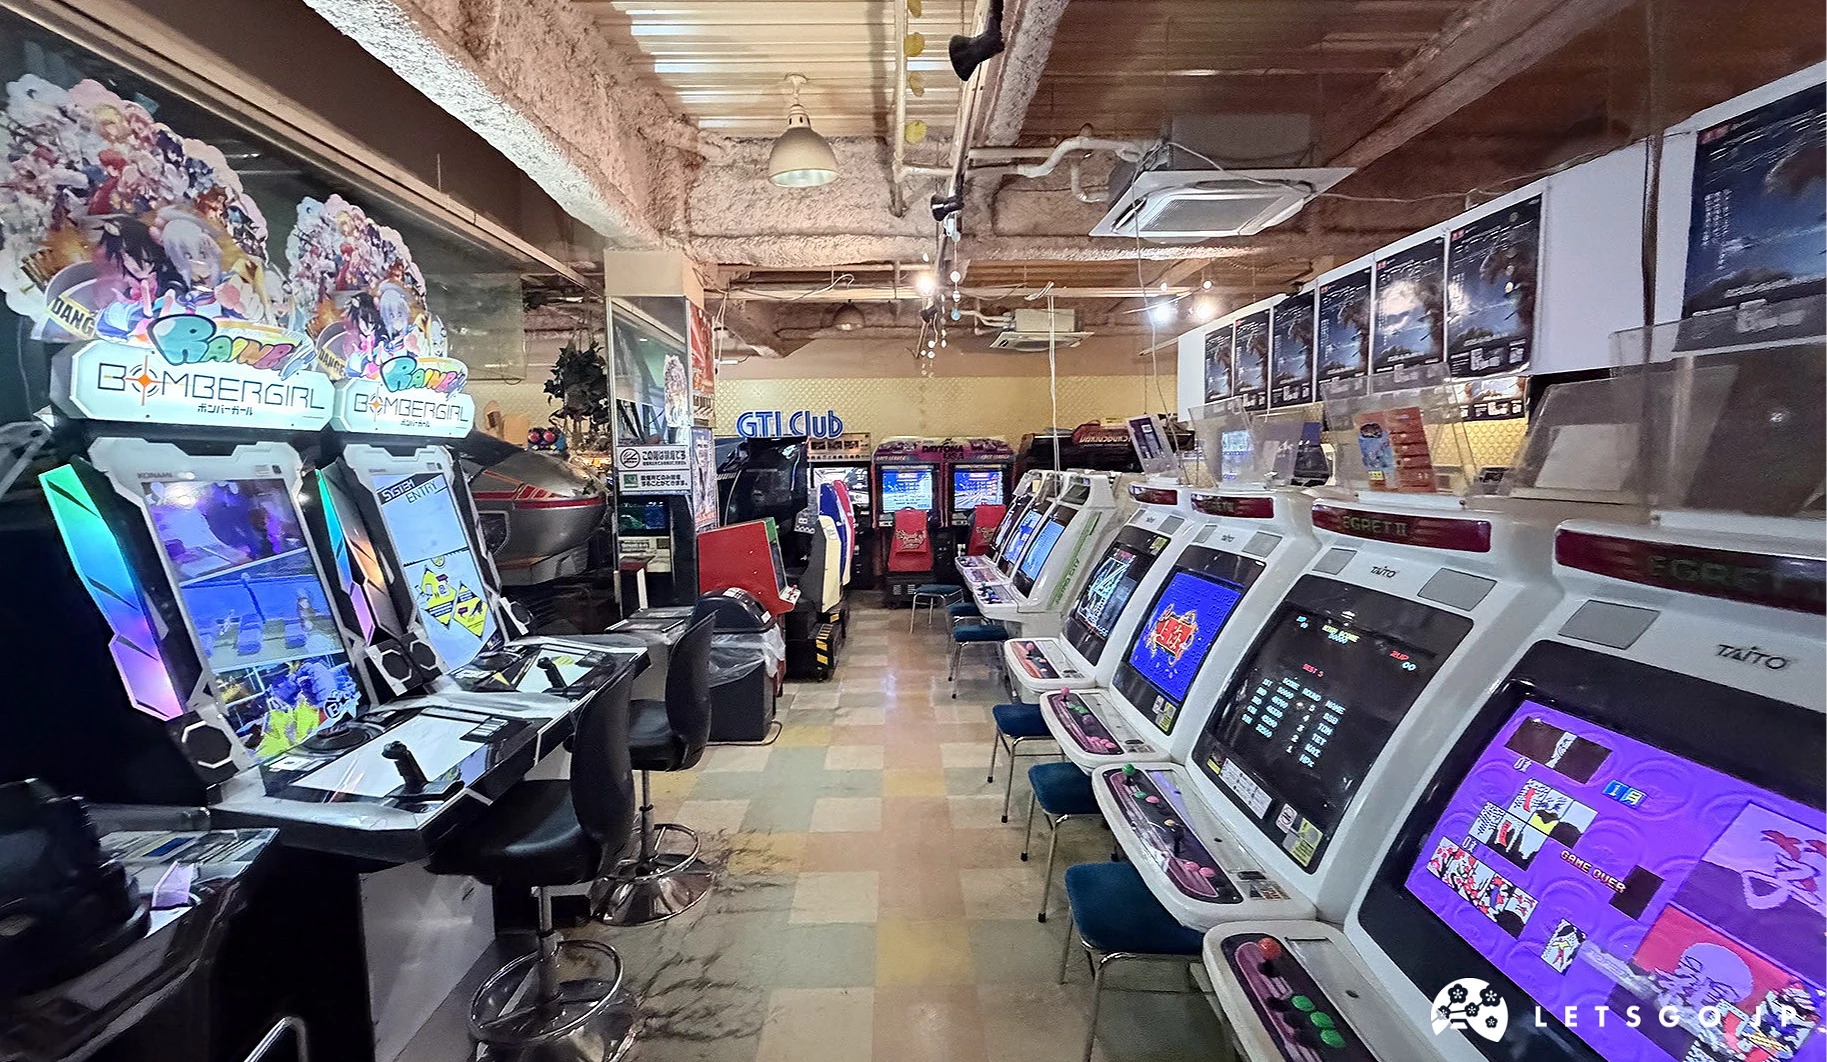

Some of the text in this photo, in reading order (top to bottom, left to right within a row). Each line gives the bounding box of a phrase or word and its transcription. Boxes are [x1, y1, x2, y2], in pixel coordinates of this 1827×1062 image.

[97, 356, 325, 410] BOMBERGIRL
[197, 403, 253, 416] ボンバーガール
[354, 387, 469, 422] BOMBERGIRL
[736, 409, 844, 439] GTI Club
[922, 445, 964, 454] DAYTONA
[406, 480, 439, 503] ENTRY
[1342, 515, 1393, 534] EGRET
[1370, 564, 1396, 579] TAITO
[1402, 661, 1416, 671] 00
[1716, 645, 1789, 670] TAITO
[1560, 849, 1626, 893] GAME OVER
